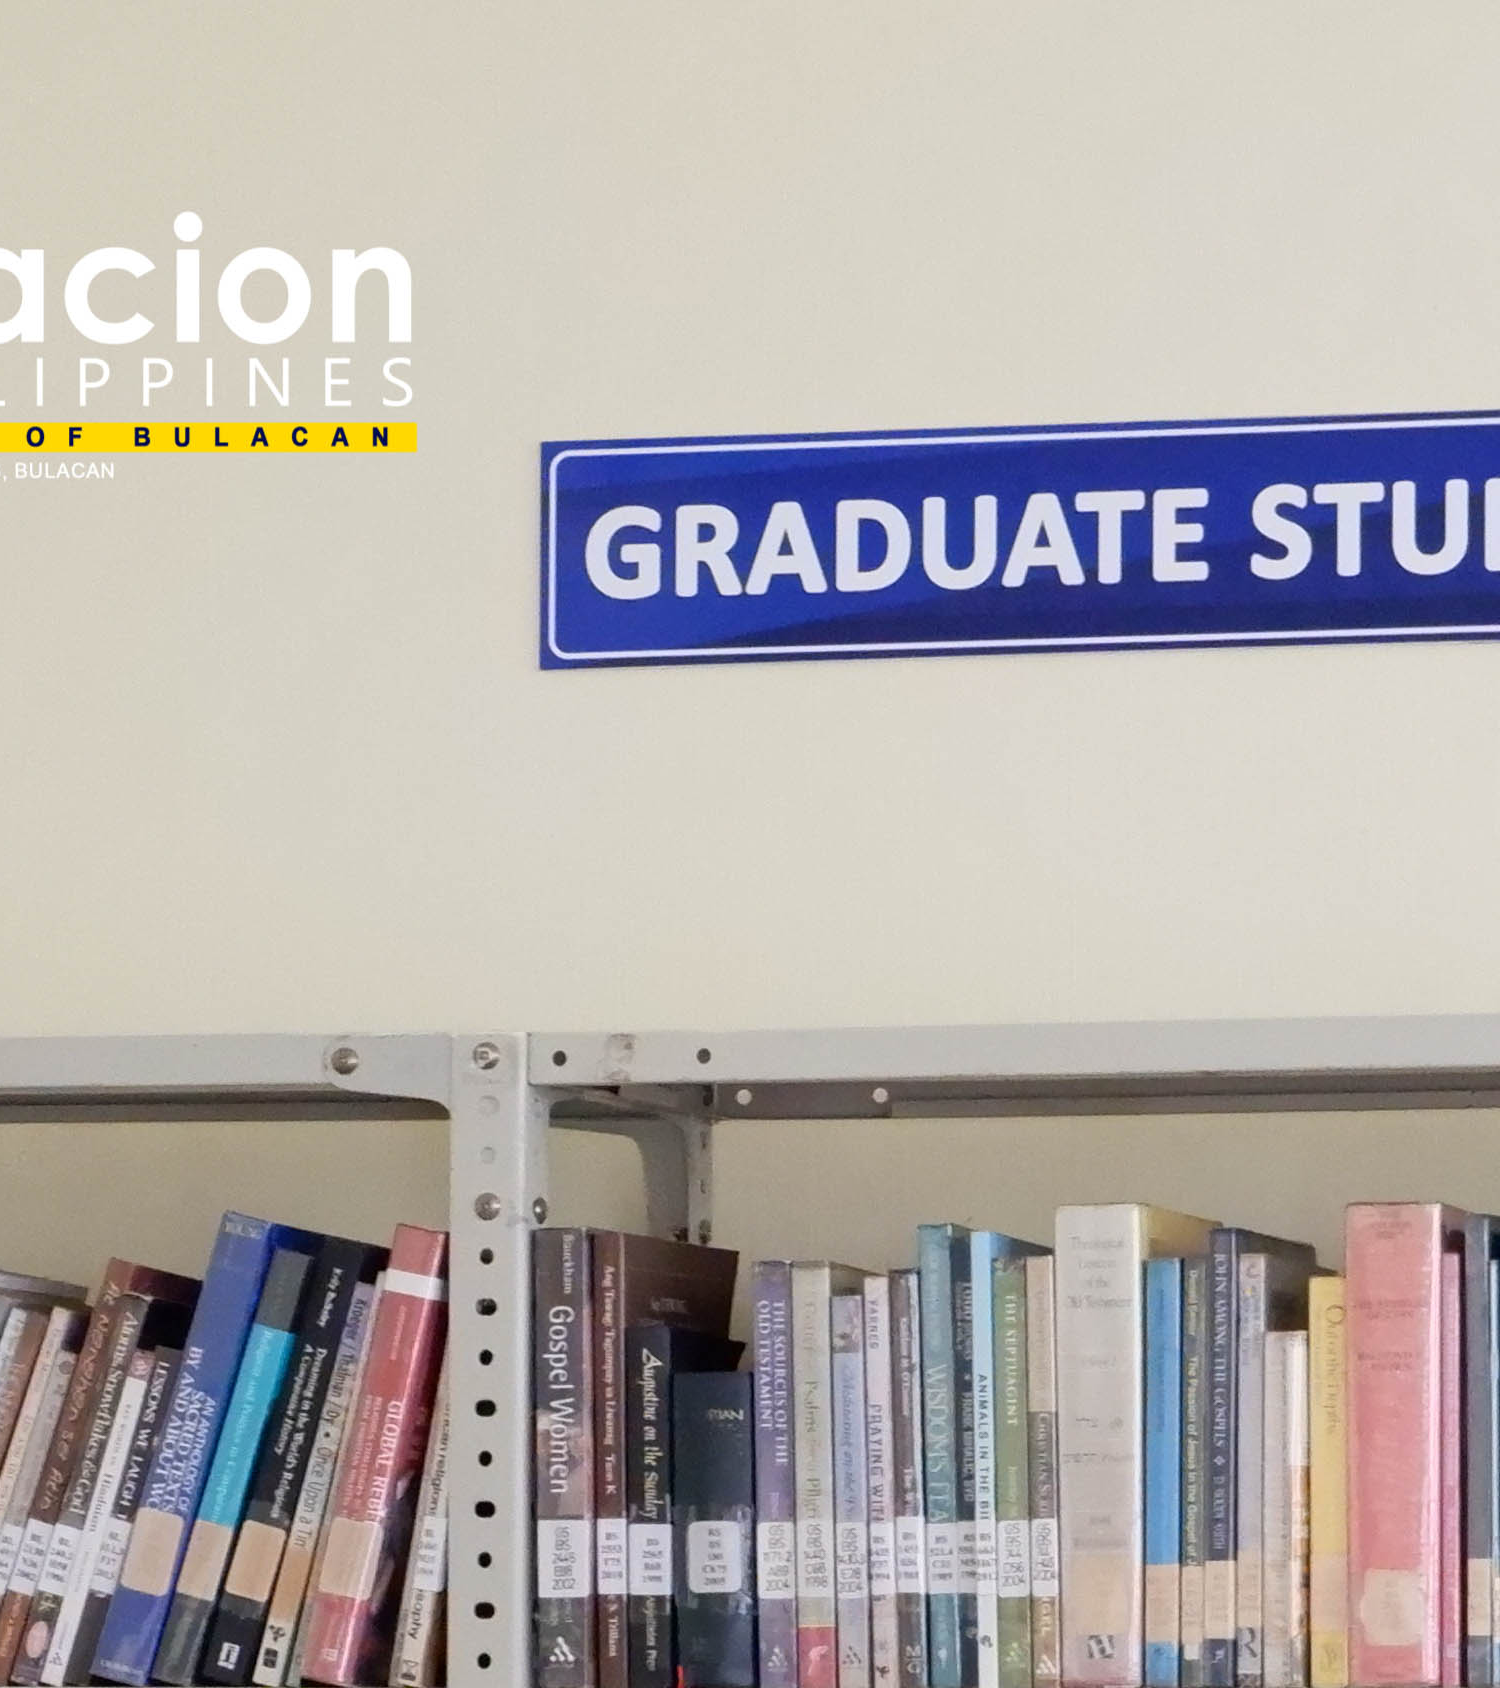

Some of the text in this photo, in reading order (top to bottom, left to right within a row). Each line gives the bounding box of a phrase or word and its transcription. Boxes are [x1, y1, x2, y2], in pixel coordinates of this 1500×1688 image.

[582, 486, 1212, 603] GRADUATE
[141, 1361, 171, 1422] LESSONS
[172, 1346, 203, 1411] BY AND
[537, 1305, 576, 1494] Gospel Women
[640, 1348, 666, 1423] Augustine
[179, 1390, 205, 1454] SACRED
[374, 1400, 404, 1468] GLOBAL
[976, 1373, 991, 1497] ANIMALS THE
